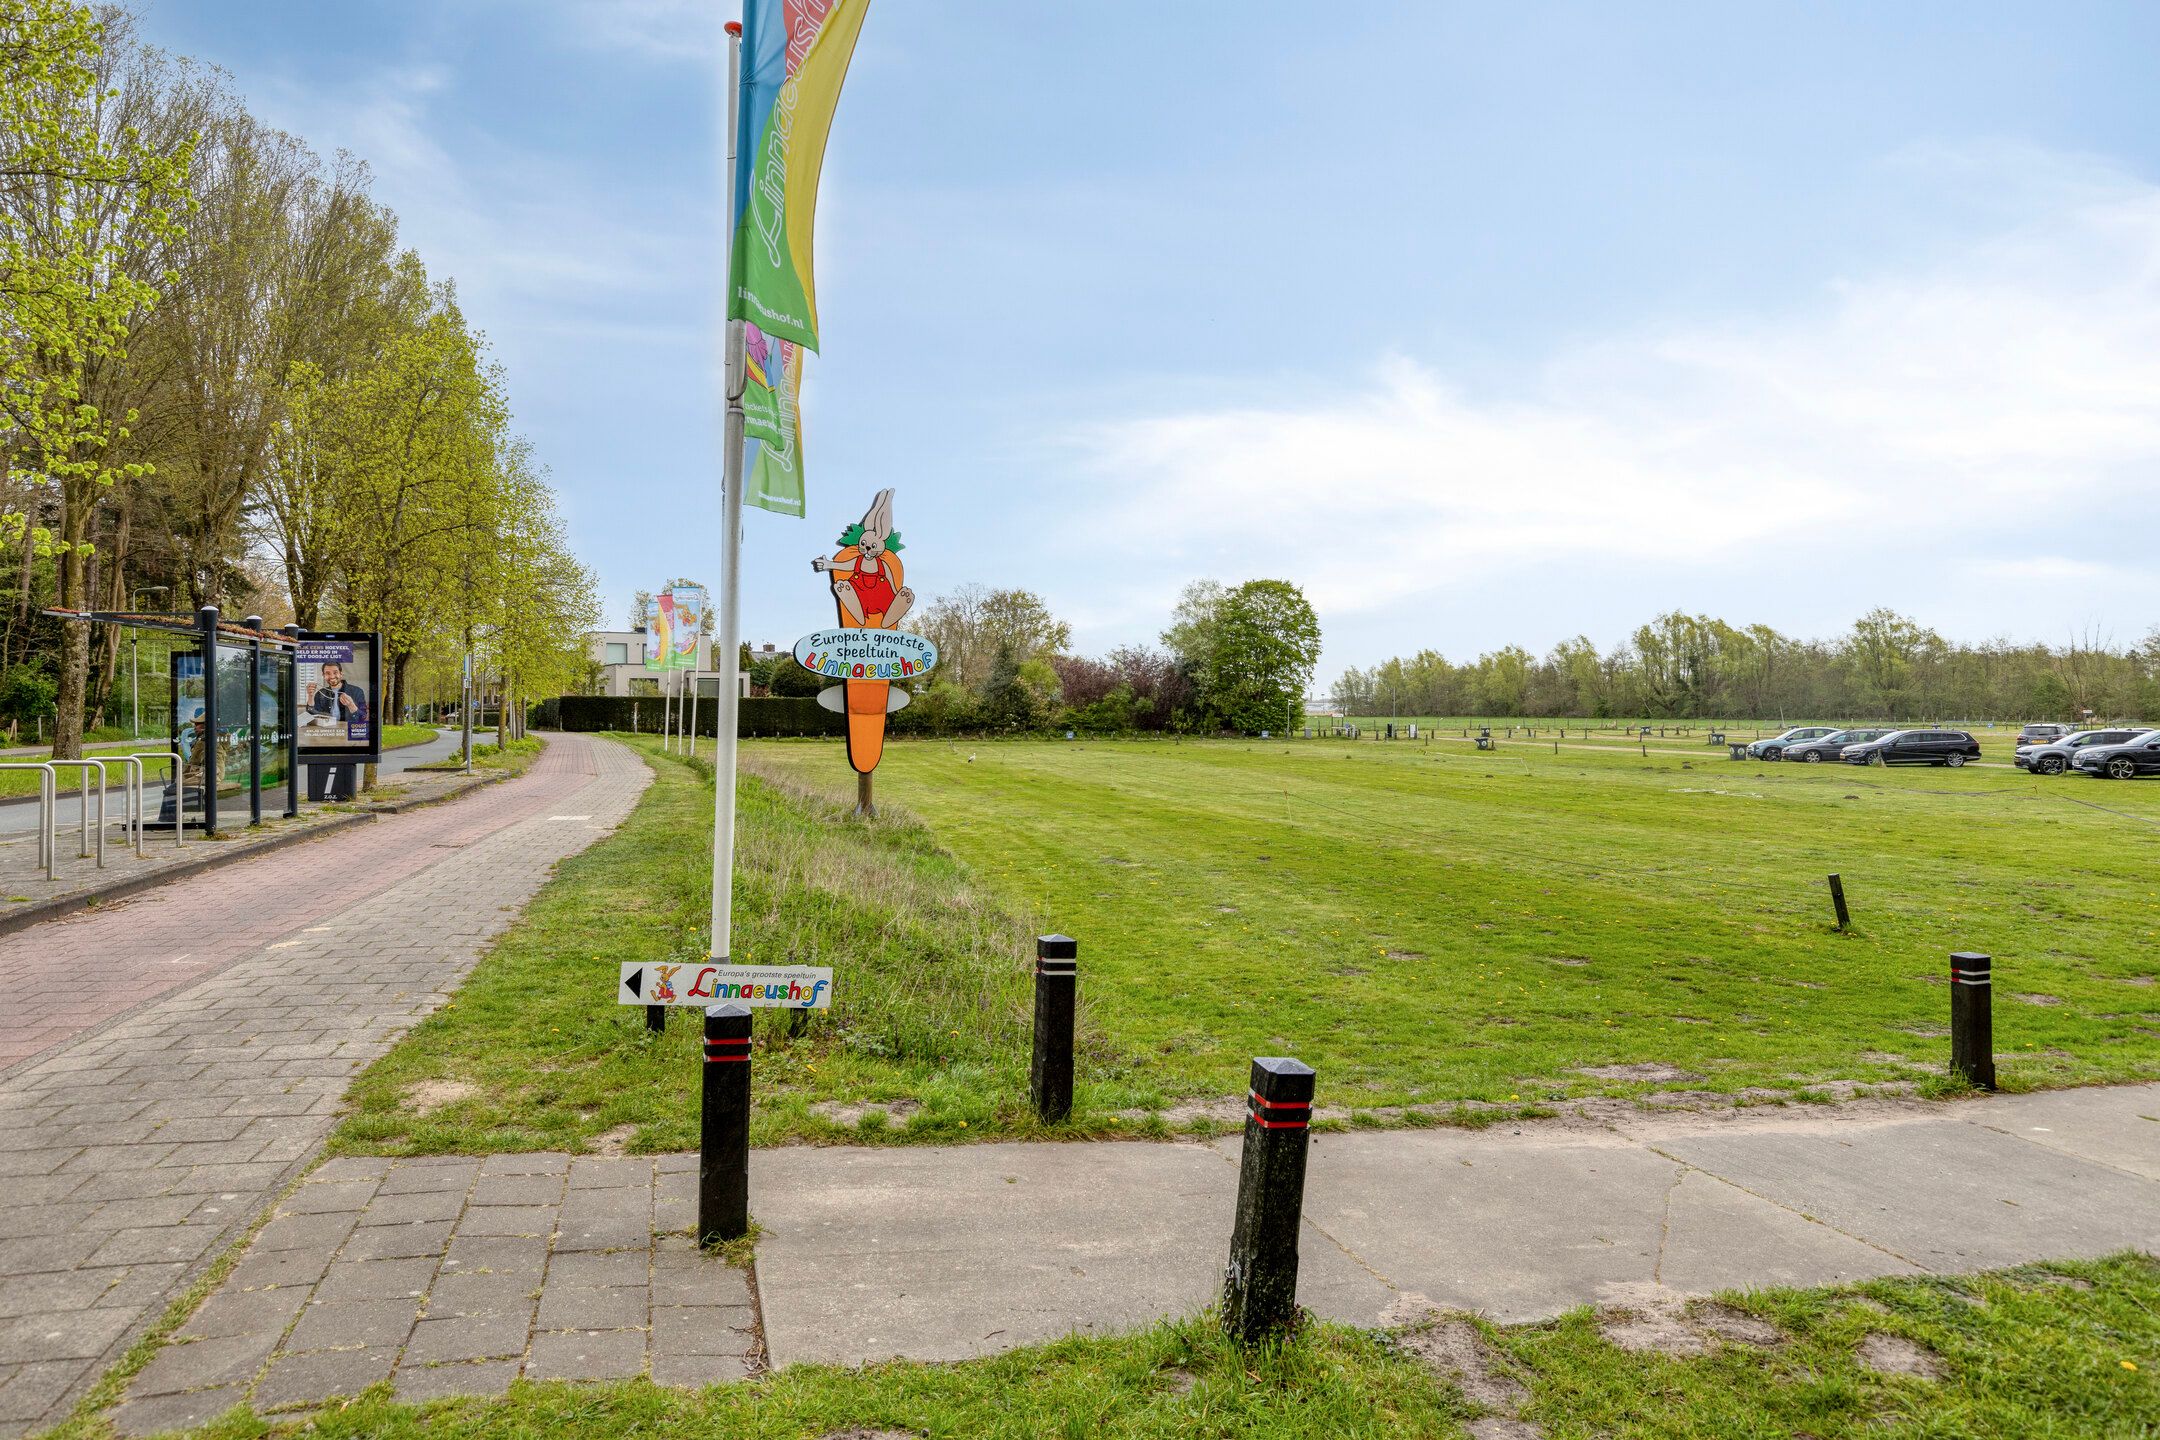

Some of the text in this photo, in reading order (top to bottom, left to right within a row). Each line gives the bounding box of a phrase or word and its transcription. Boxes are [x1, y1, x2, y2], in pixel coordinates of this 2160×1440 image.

[749, 0, 841, 268] Linnaeush
[810, 629, 925, 651] Europa's grootste
[836, 643, 899, 660] speeltuin
[804, 651, 932, 678] Linnaeushof
[718, 969, 750, 978] Europa's
[687, 967, 829, 1007] Linnaeushof
